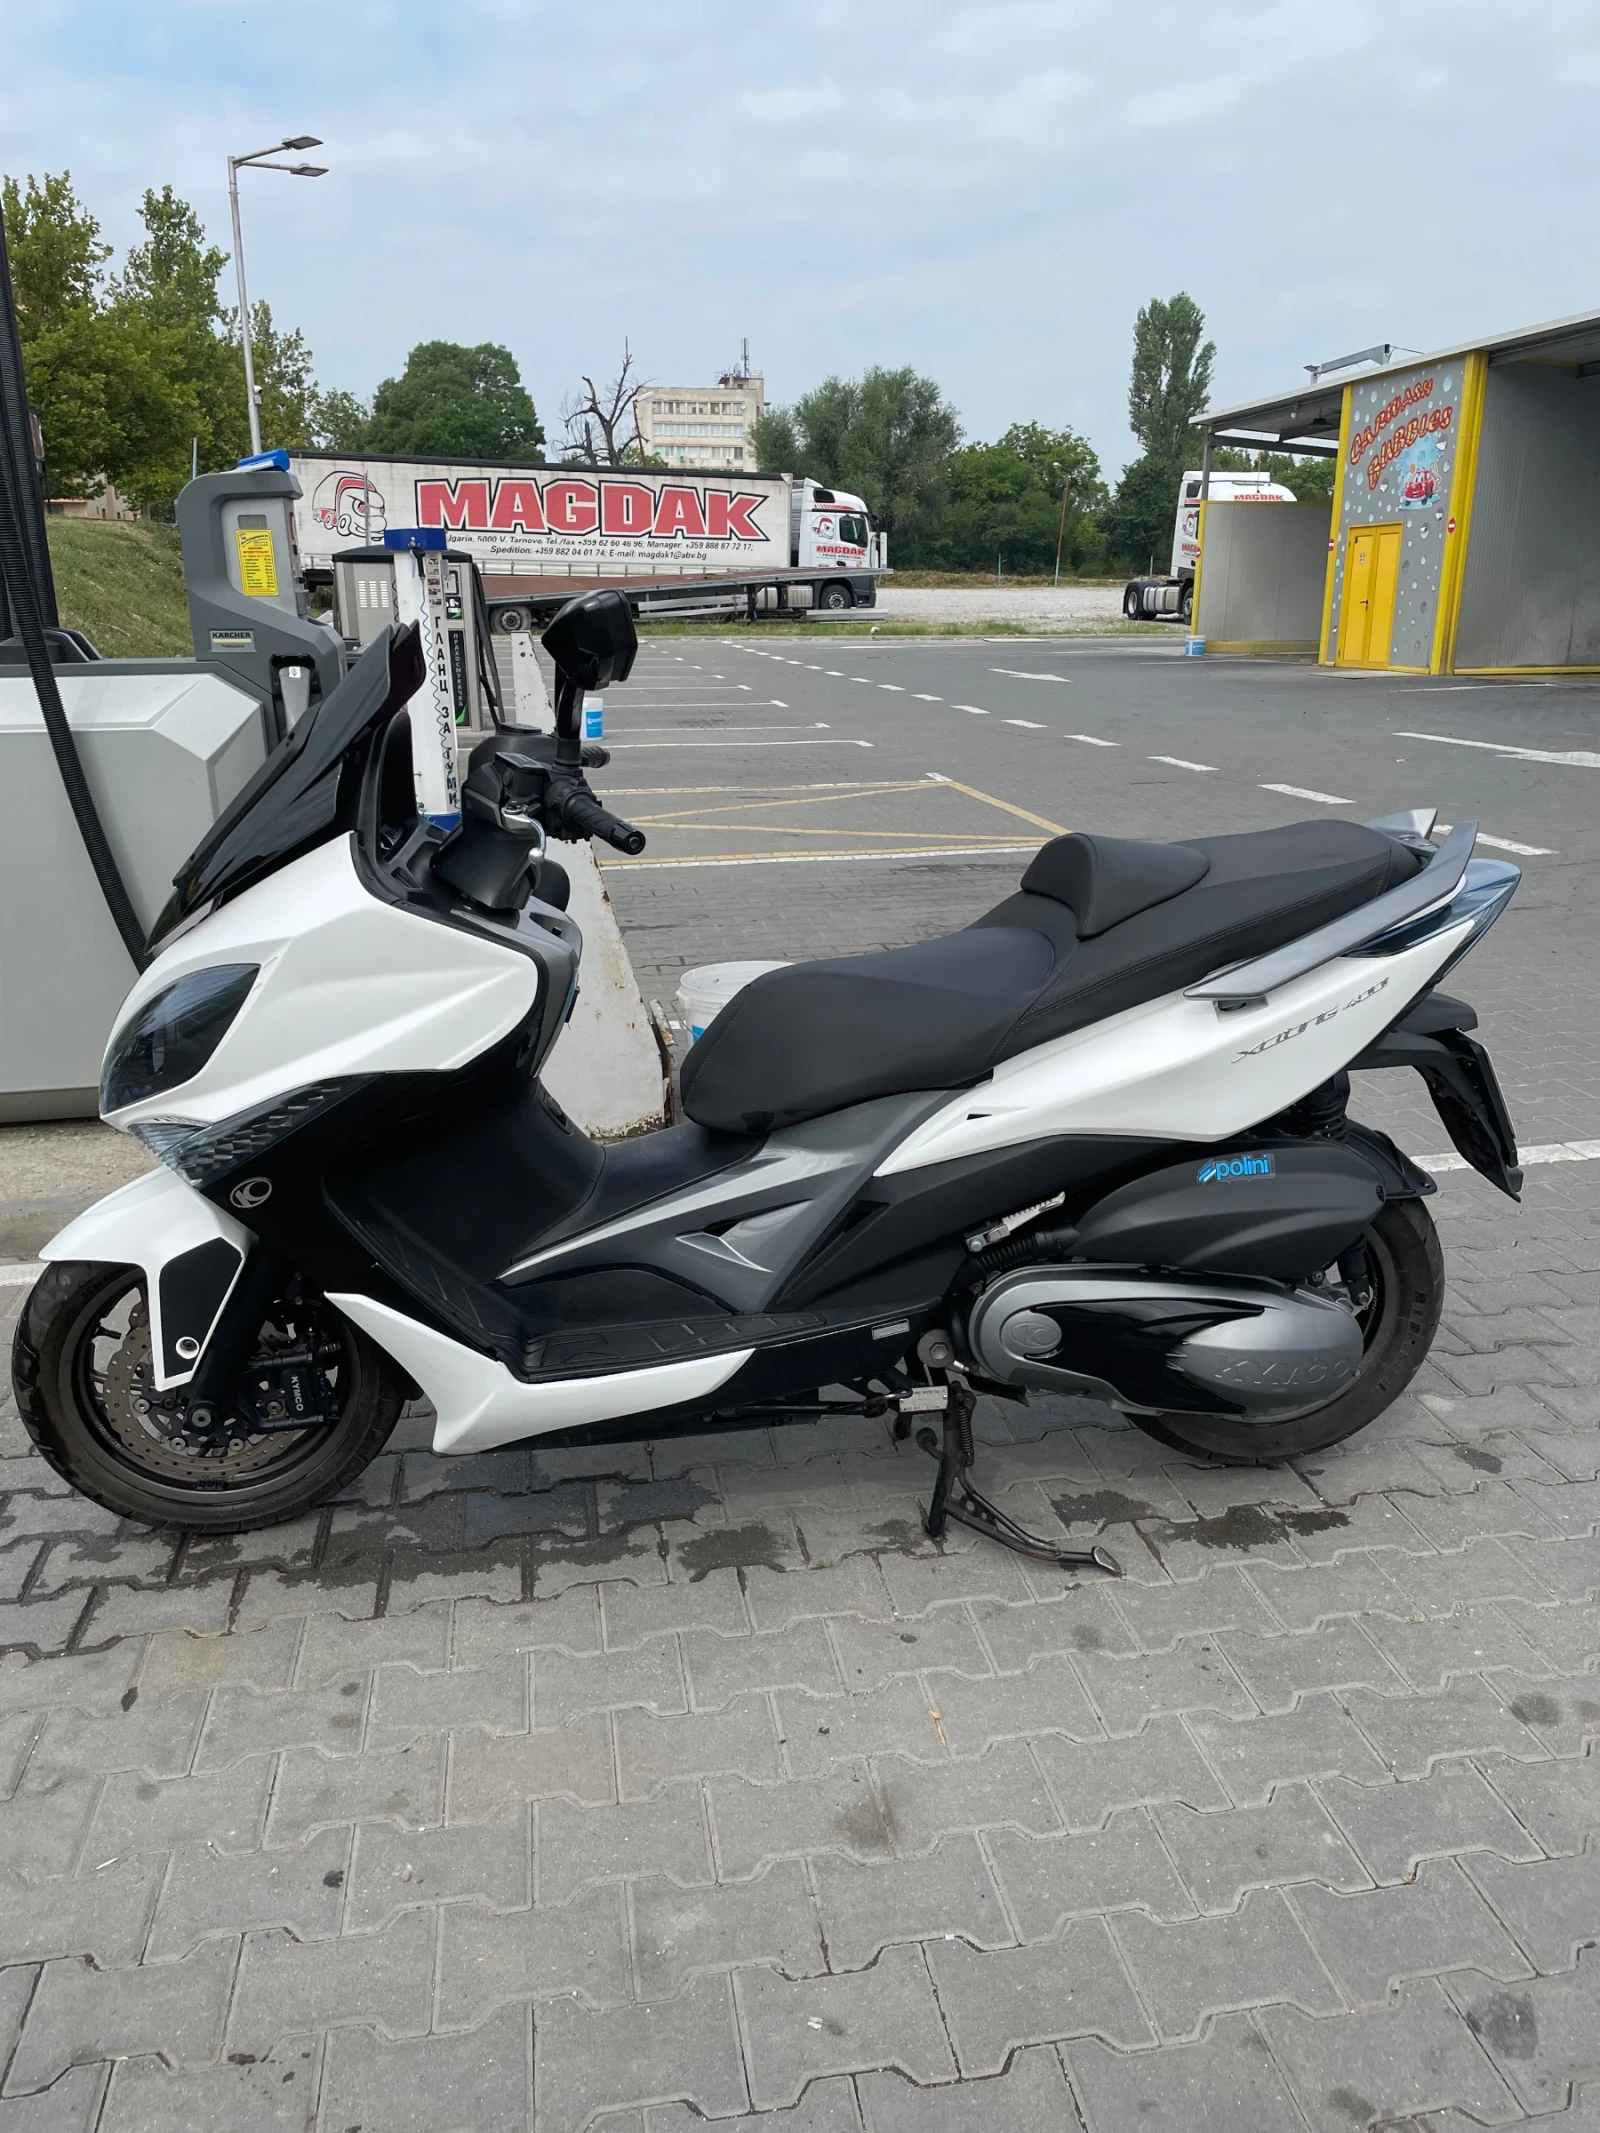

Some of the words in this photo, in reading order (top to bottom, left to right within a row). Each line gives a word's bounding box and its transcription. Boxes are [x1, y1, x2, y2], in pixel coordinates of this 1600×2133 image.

[414, 478, 771, 542] MAGDAK
[448, 534, 474, 543] lgaria,
[477, 535, 498, 543] 5000
[510, 536, 543, 545] Tarnovo,
[577, 538, 598, 546] +359
[647, 541, 683, 550] Manager:
[685, 541, 704, 549] +359
[490, 545, 533, 555] Spedition:
[535, 547, 554, 555] +359
[555, 547, 571, 556] 882
[571, 548, 582, 556] 04
[583, 548, 593, 556] 01
[609, 549, 636, 558] E-mail:
[638, 550, 707, 560] magdak1@abv.bg
[816, 545, 867, 556] MAGDAK
[434, 616, 448, 694] ГЛАНЦ
[1215, 1154, 1269, 1180] polini
[1215, 1354, 1352, 1385] KYMCO
[291, 1376, 304, 1411] KYMCO
